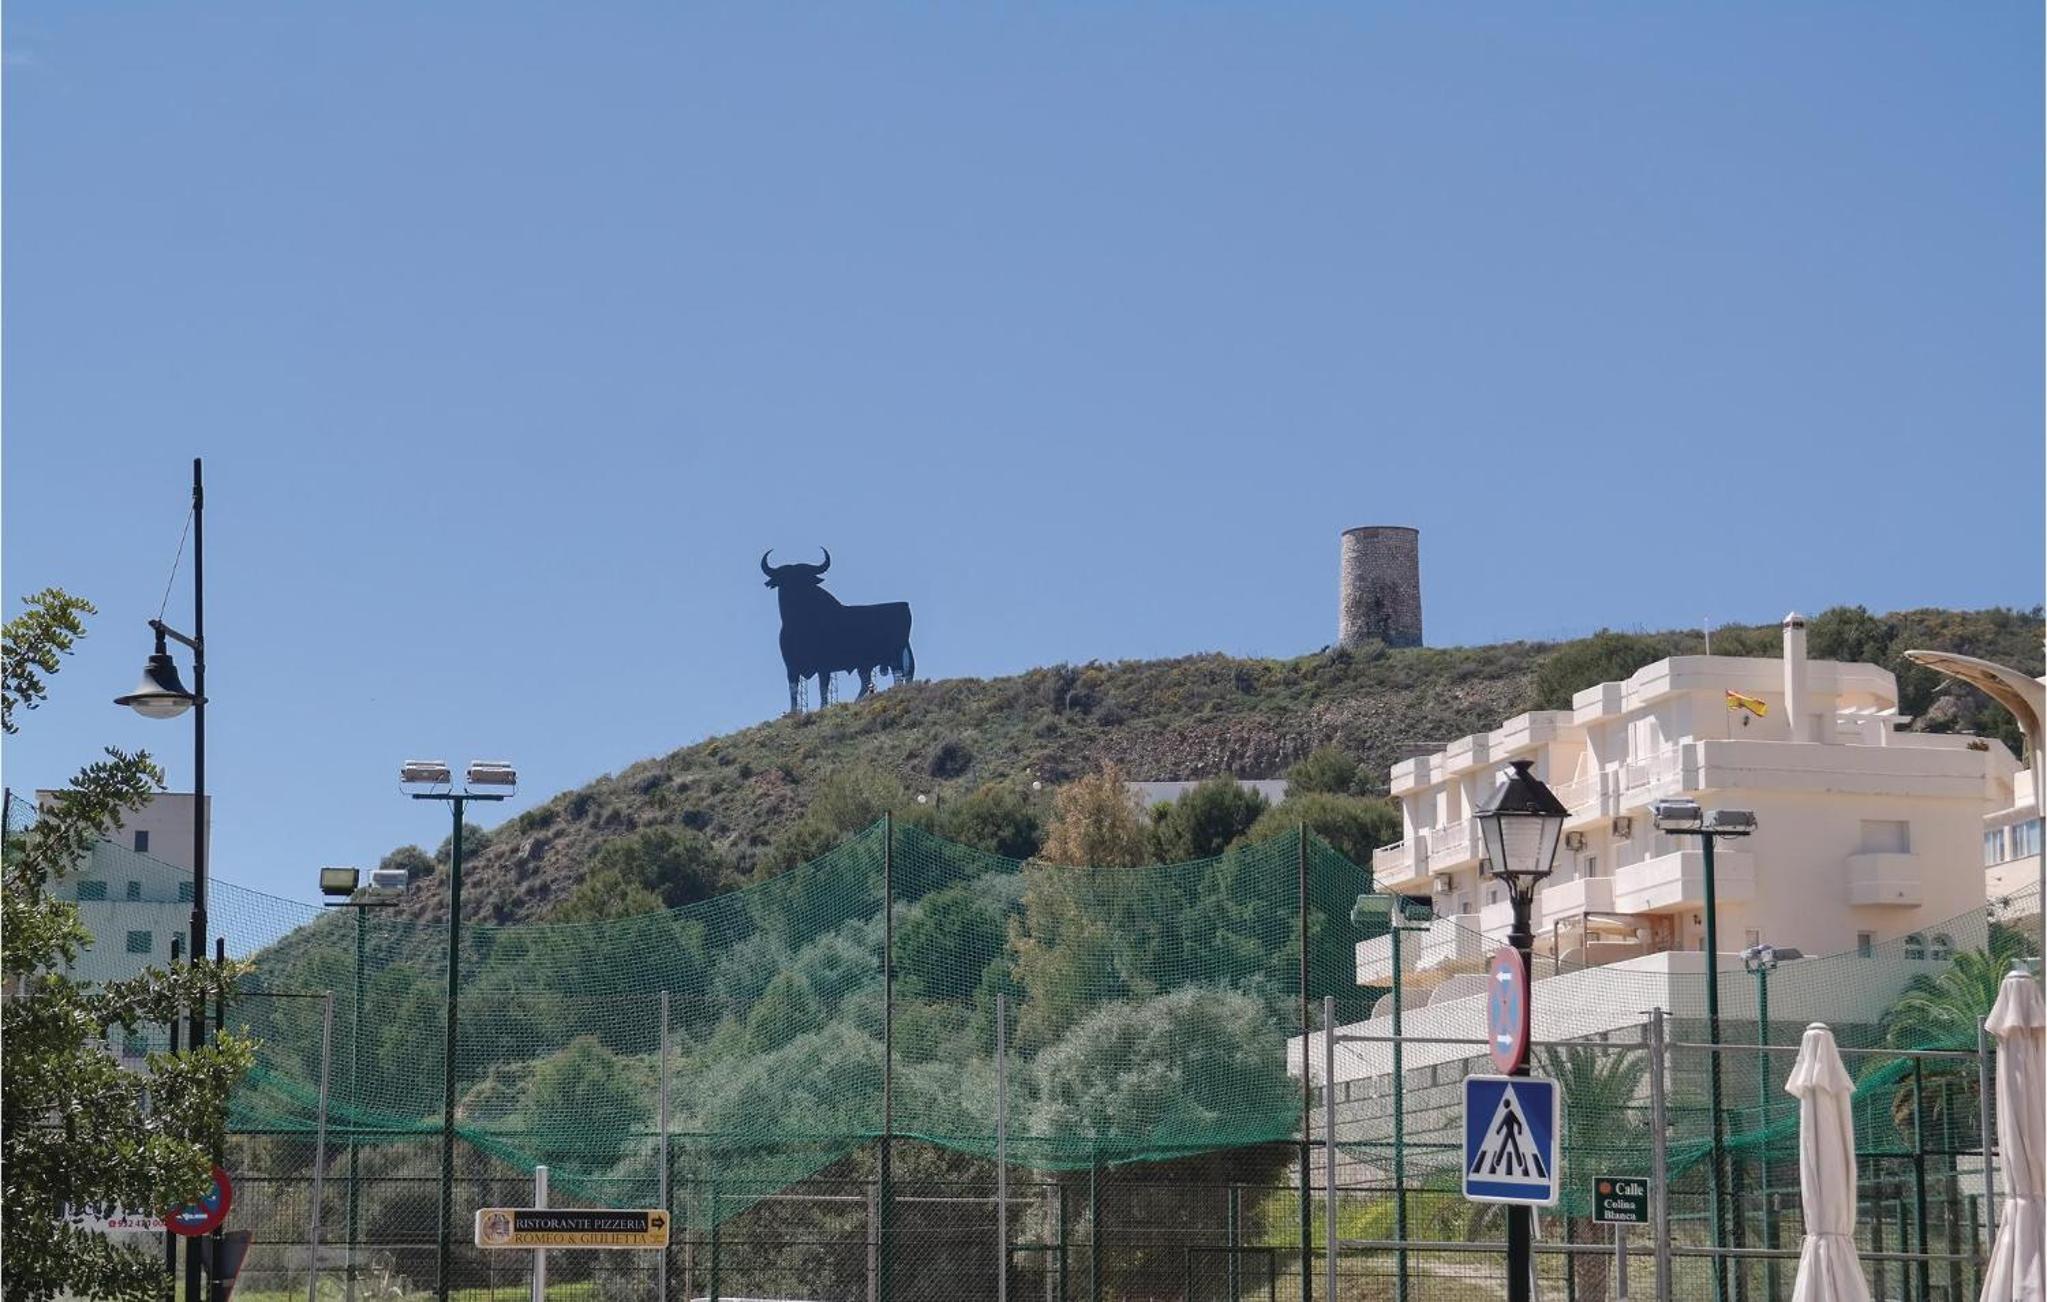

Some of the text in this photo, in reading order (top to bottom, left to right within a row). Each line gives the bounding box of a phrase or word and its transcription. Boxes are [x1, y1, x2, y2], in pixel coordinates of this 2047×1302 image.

[1615, 1182, 1644, 1196] Calle
[1603, 1199, 1636, 1209] Colina
[1604, 1210, 1637, 1220] Blanca
[516, 1219, 647, 1229] RISTORANTE PIZZERIA
[515, 1233, 564, 1244] ROMEO
[568, 1233, 577, 1244] &
[580, 1233, 647, 1244] GIULIETTA
